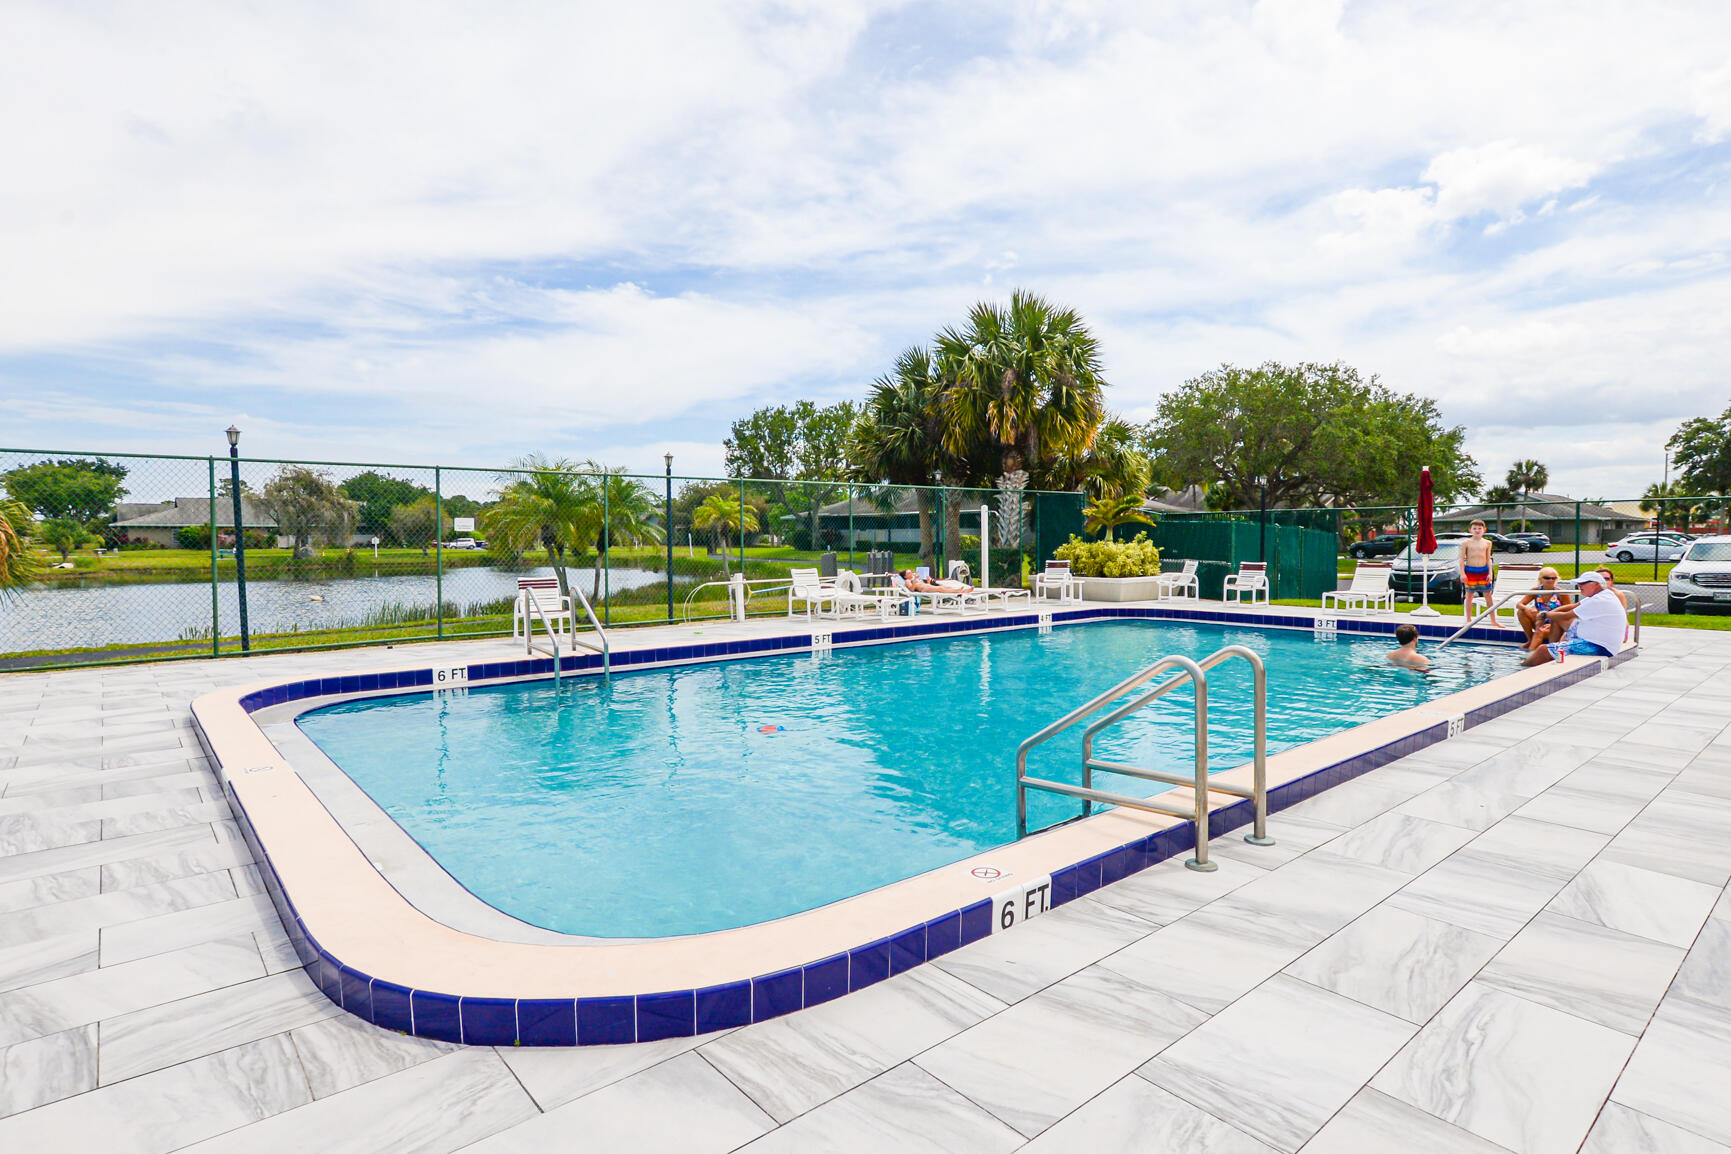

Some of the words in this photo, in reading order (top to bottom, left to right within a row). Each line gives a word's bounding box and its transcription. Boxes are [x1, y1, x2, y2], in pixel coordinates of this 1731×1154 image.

[1317, 619, 1323, 627] 3
[814, 635, 820, 644] 5
[437, 670, 446, 681] 6
[1001, 900, 1015, 930] 6
[1025, 883, 1050, 920] FT.
